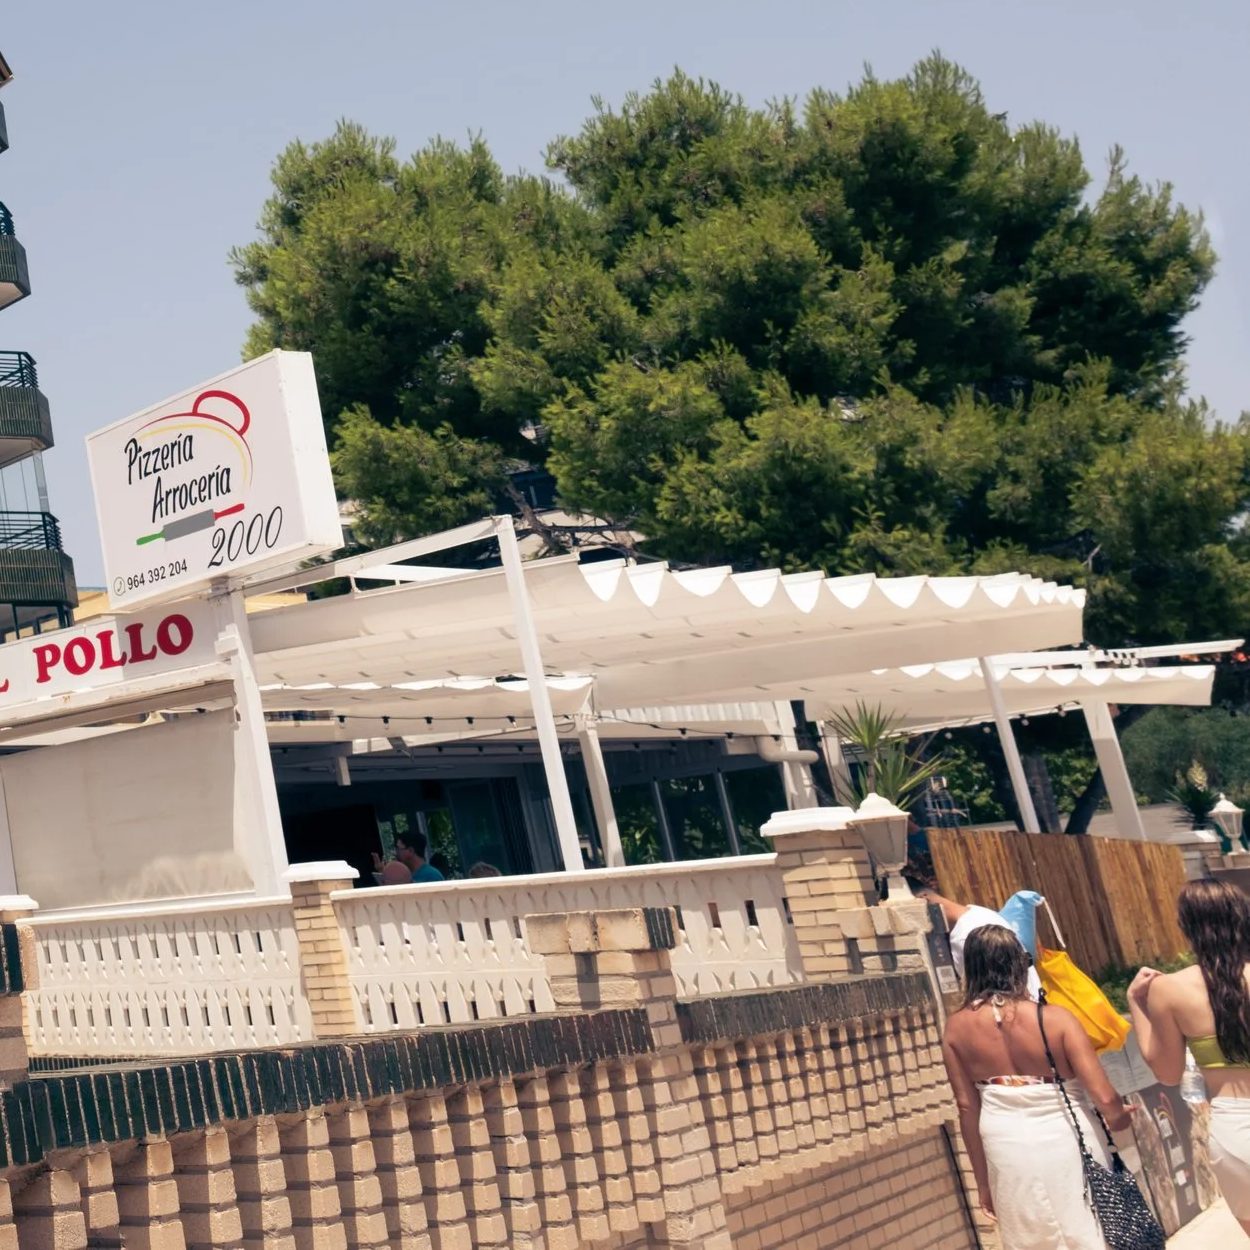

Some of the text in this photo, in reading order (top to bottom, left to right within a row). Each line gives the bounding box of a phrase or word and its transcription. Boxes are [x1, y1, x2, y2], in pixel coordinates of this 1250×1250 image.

[124, 433, 194, 485] Pizzería
[151, 465, 232, 524] Arrocería
[207, 506, 283, 569] 2000
[127, 559, 188, 590] 964 392 204
[32, 613, 194, 685] POLLO
